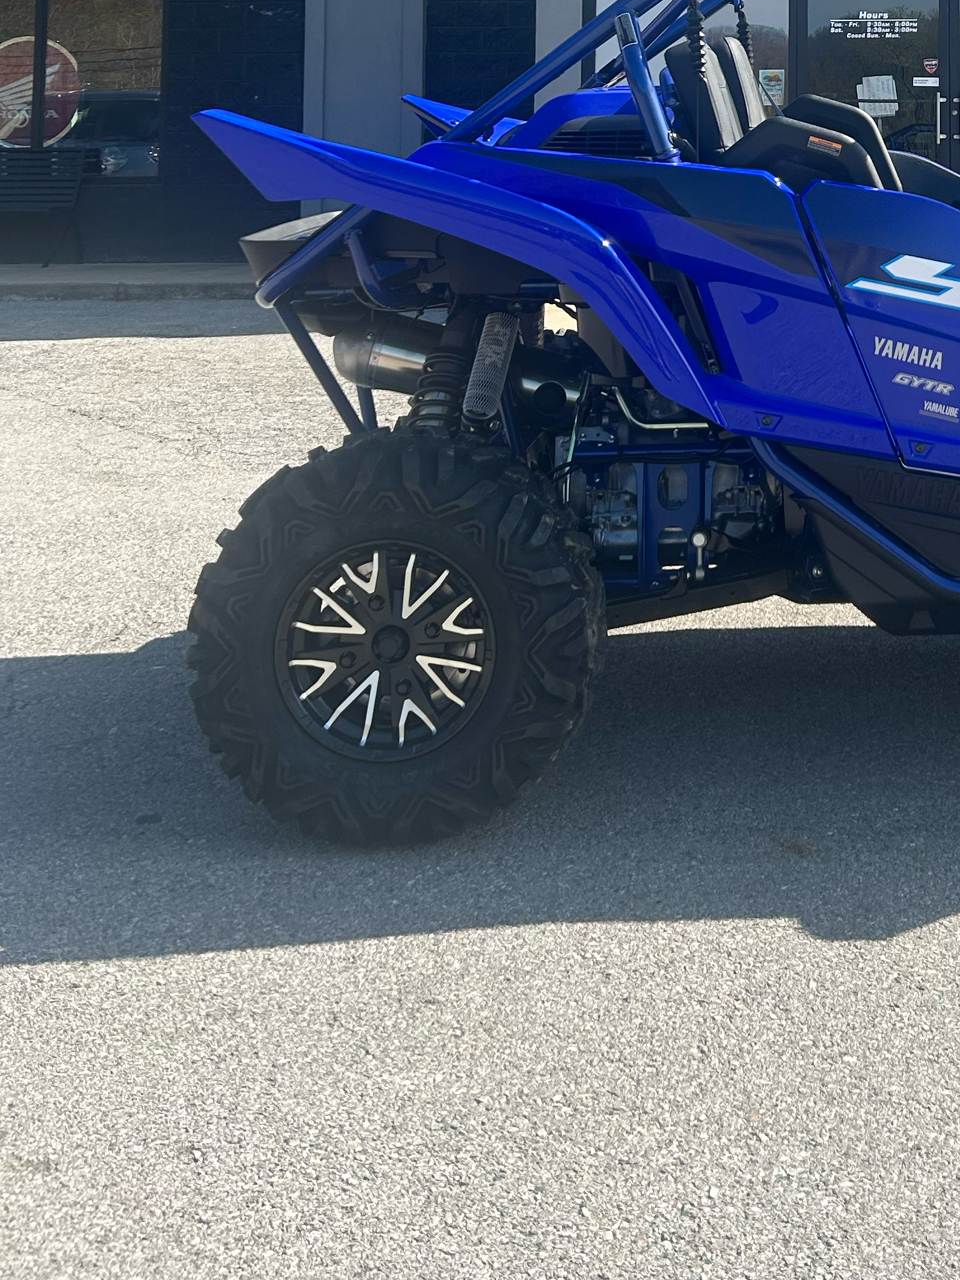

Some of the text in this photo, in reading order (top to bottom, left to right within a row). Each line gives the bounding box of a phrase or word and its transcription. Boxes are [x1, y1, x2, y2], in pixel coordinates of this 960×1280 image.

[859, 11, 889, 19] Hours
[874, 336, 943, 370] YAMAHA
[892, 372, 955, 396] GYTR
[924, 400, 960, 418] YAMALUBE
